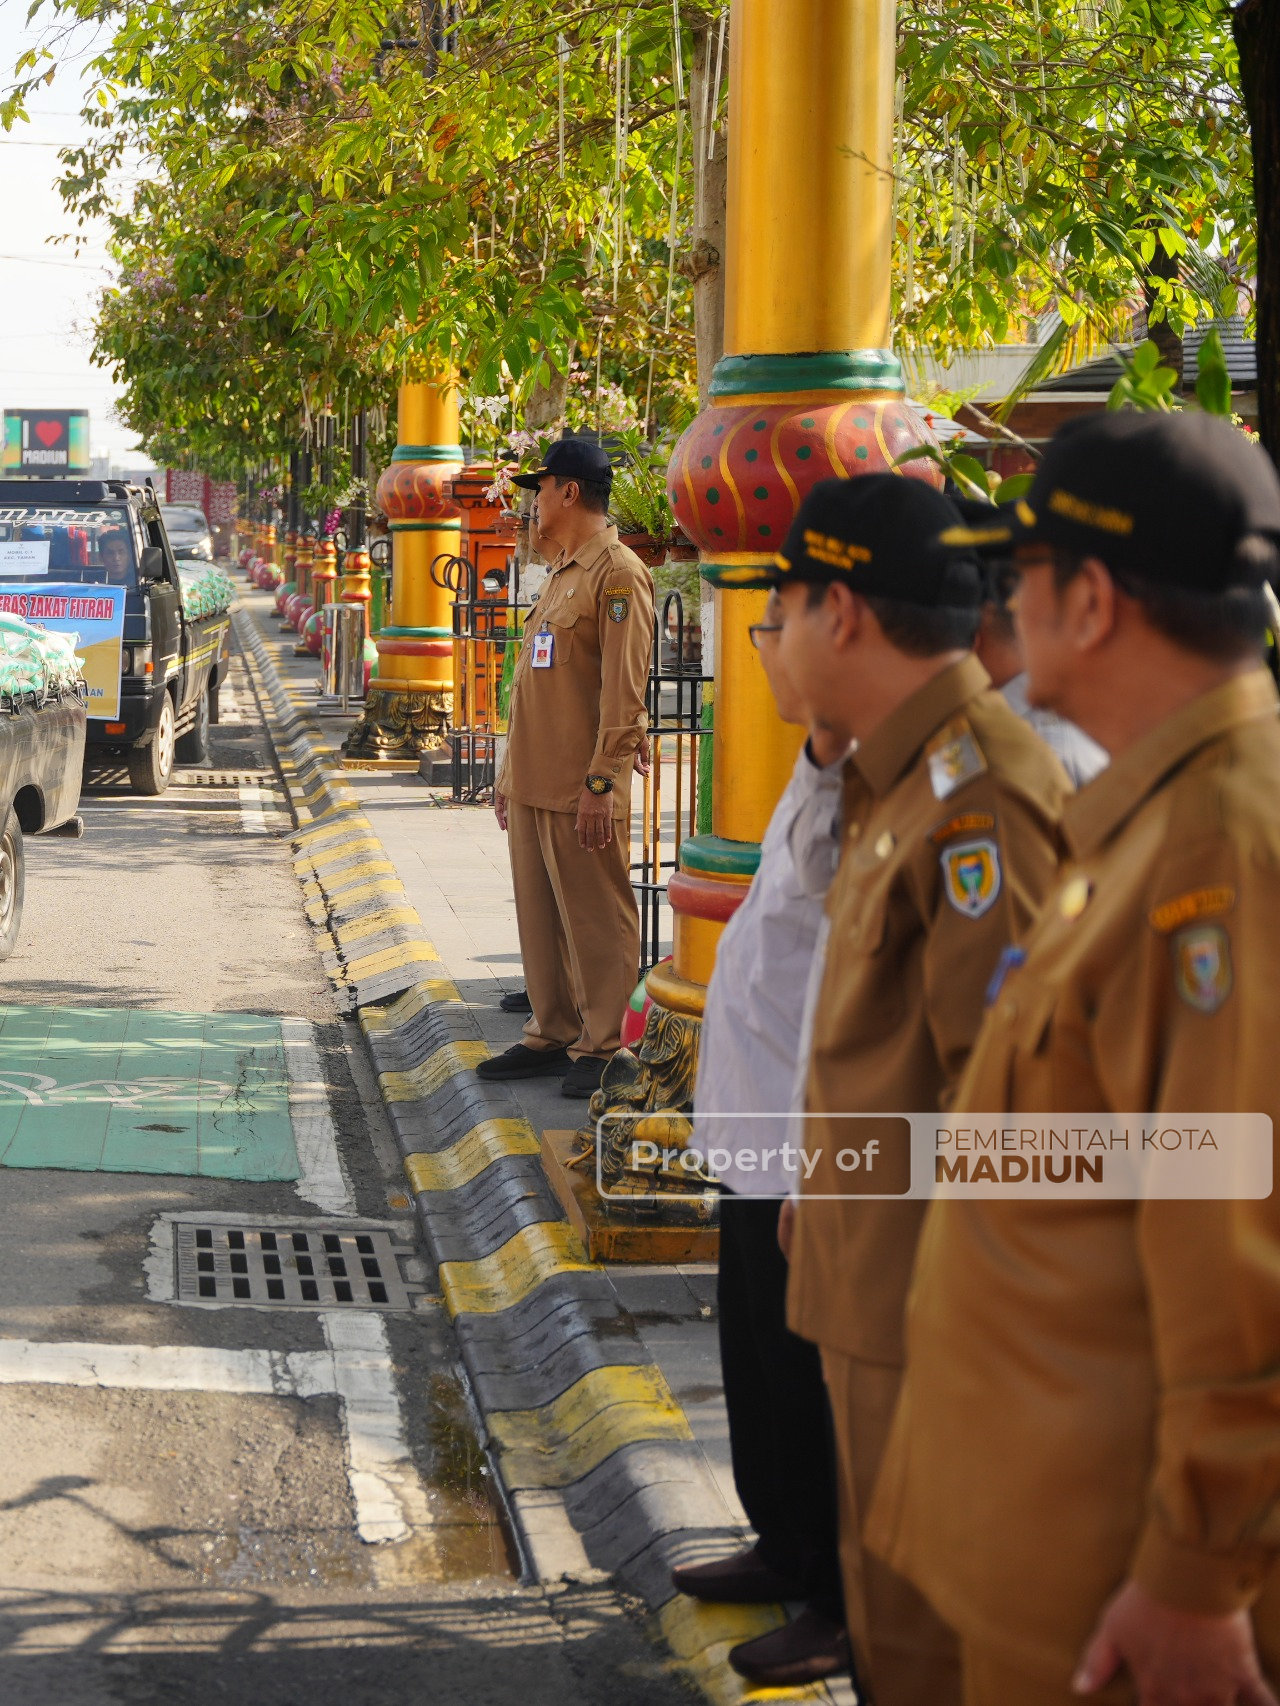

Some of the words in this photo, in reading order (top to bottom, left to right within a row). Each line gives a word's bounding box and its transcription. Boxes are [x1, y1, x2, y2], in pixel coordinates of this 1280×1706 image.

[22, 449, 68, 465] MADIUN
[28, 596, 69, 619] ZAKAT
[69, 597, 115, 619] FITRAH
